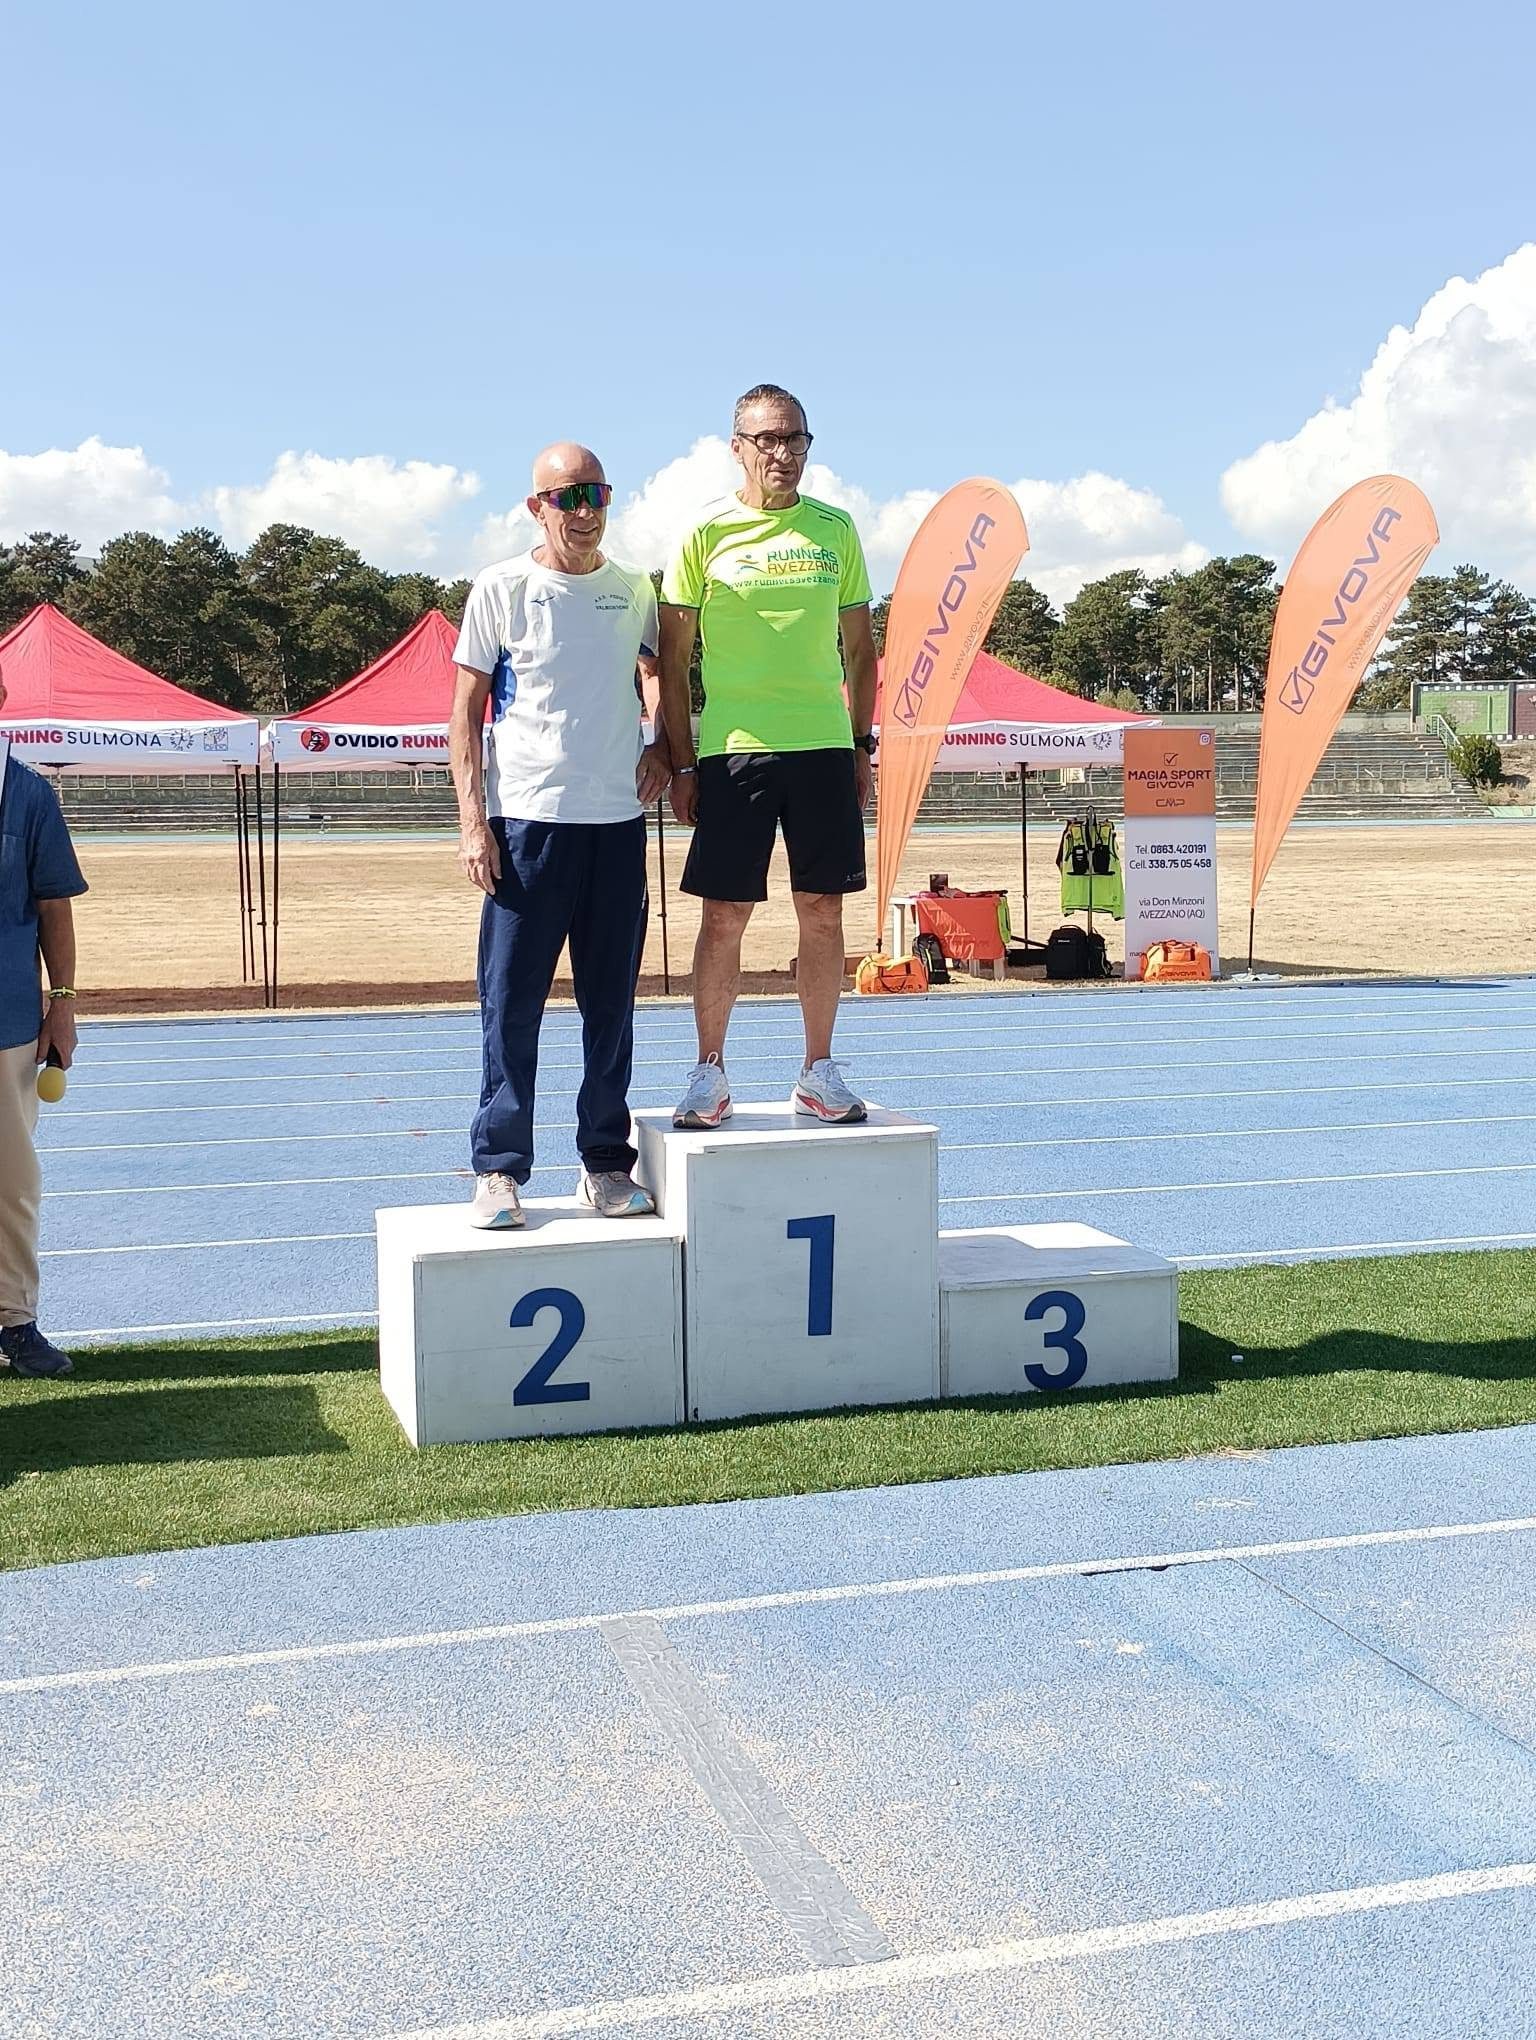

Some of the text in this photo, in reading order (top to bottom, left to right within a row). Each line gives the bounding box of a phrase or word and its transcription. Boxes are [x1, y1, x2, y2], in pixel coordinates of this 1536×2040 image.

[767, 548, 838, 563] RUNNERS
[1300, 506, 1402, 678] GIVOVA
[911, 512, 996, 690] GIVOVA
[67, 731, 162, 747] SULMONA
[334, 734, 399, 748] OVIDIO
[940, 733, 1007, 747] UNNING
[1009, 734, 1086, 748] SULMONA
[1128, 770, 1212, 780] MAGIA SPORT
[1146, 781, 1195, 789] GIVOVA
[1155, 798, 1186, 808] CMP
[1180, 859, 1192, 868] 05
[1194, 858, 1212, 868] 458
[1139, 896, 1205, 906] via Don Minzoni
[1138, 909, 1206, 919] AVEZZANO (AQ)
[787, 1214, 835, 1336] 1
[509, 1287, 591, 1406] 2
[1023, 1290, 1089, 1390] 3
